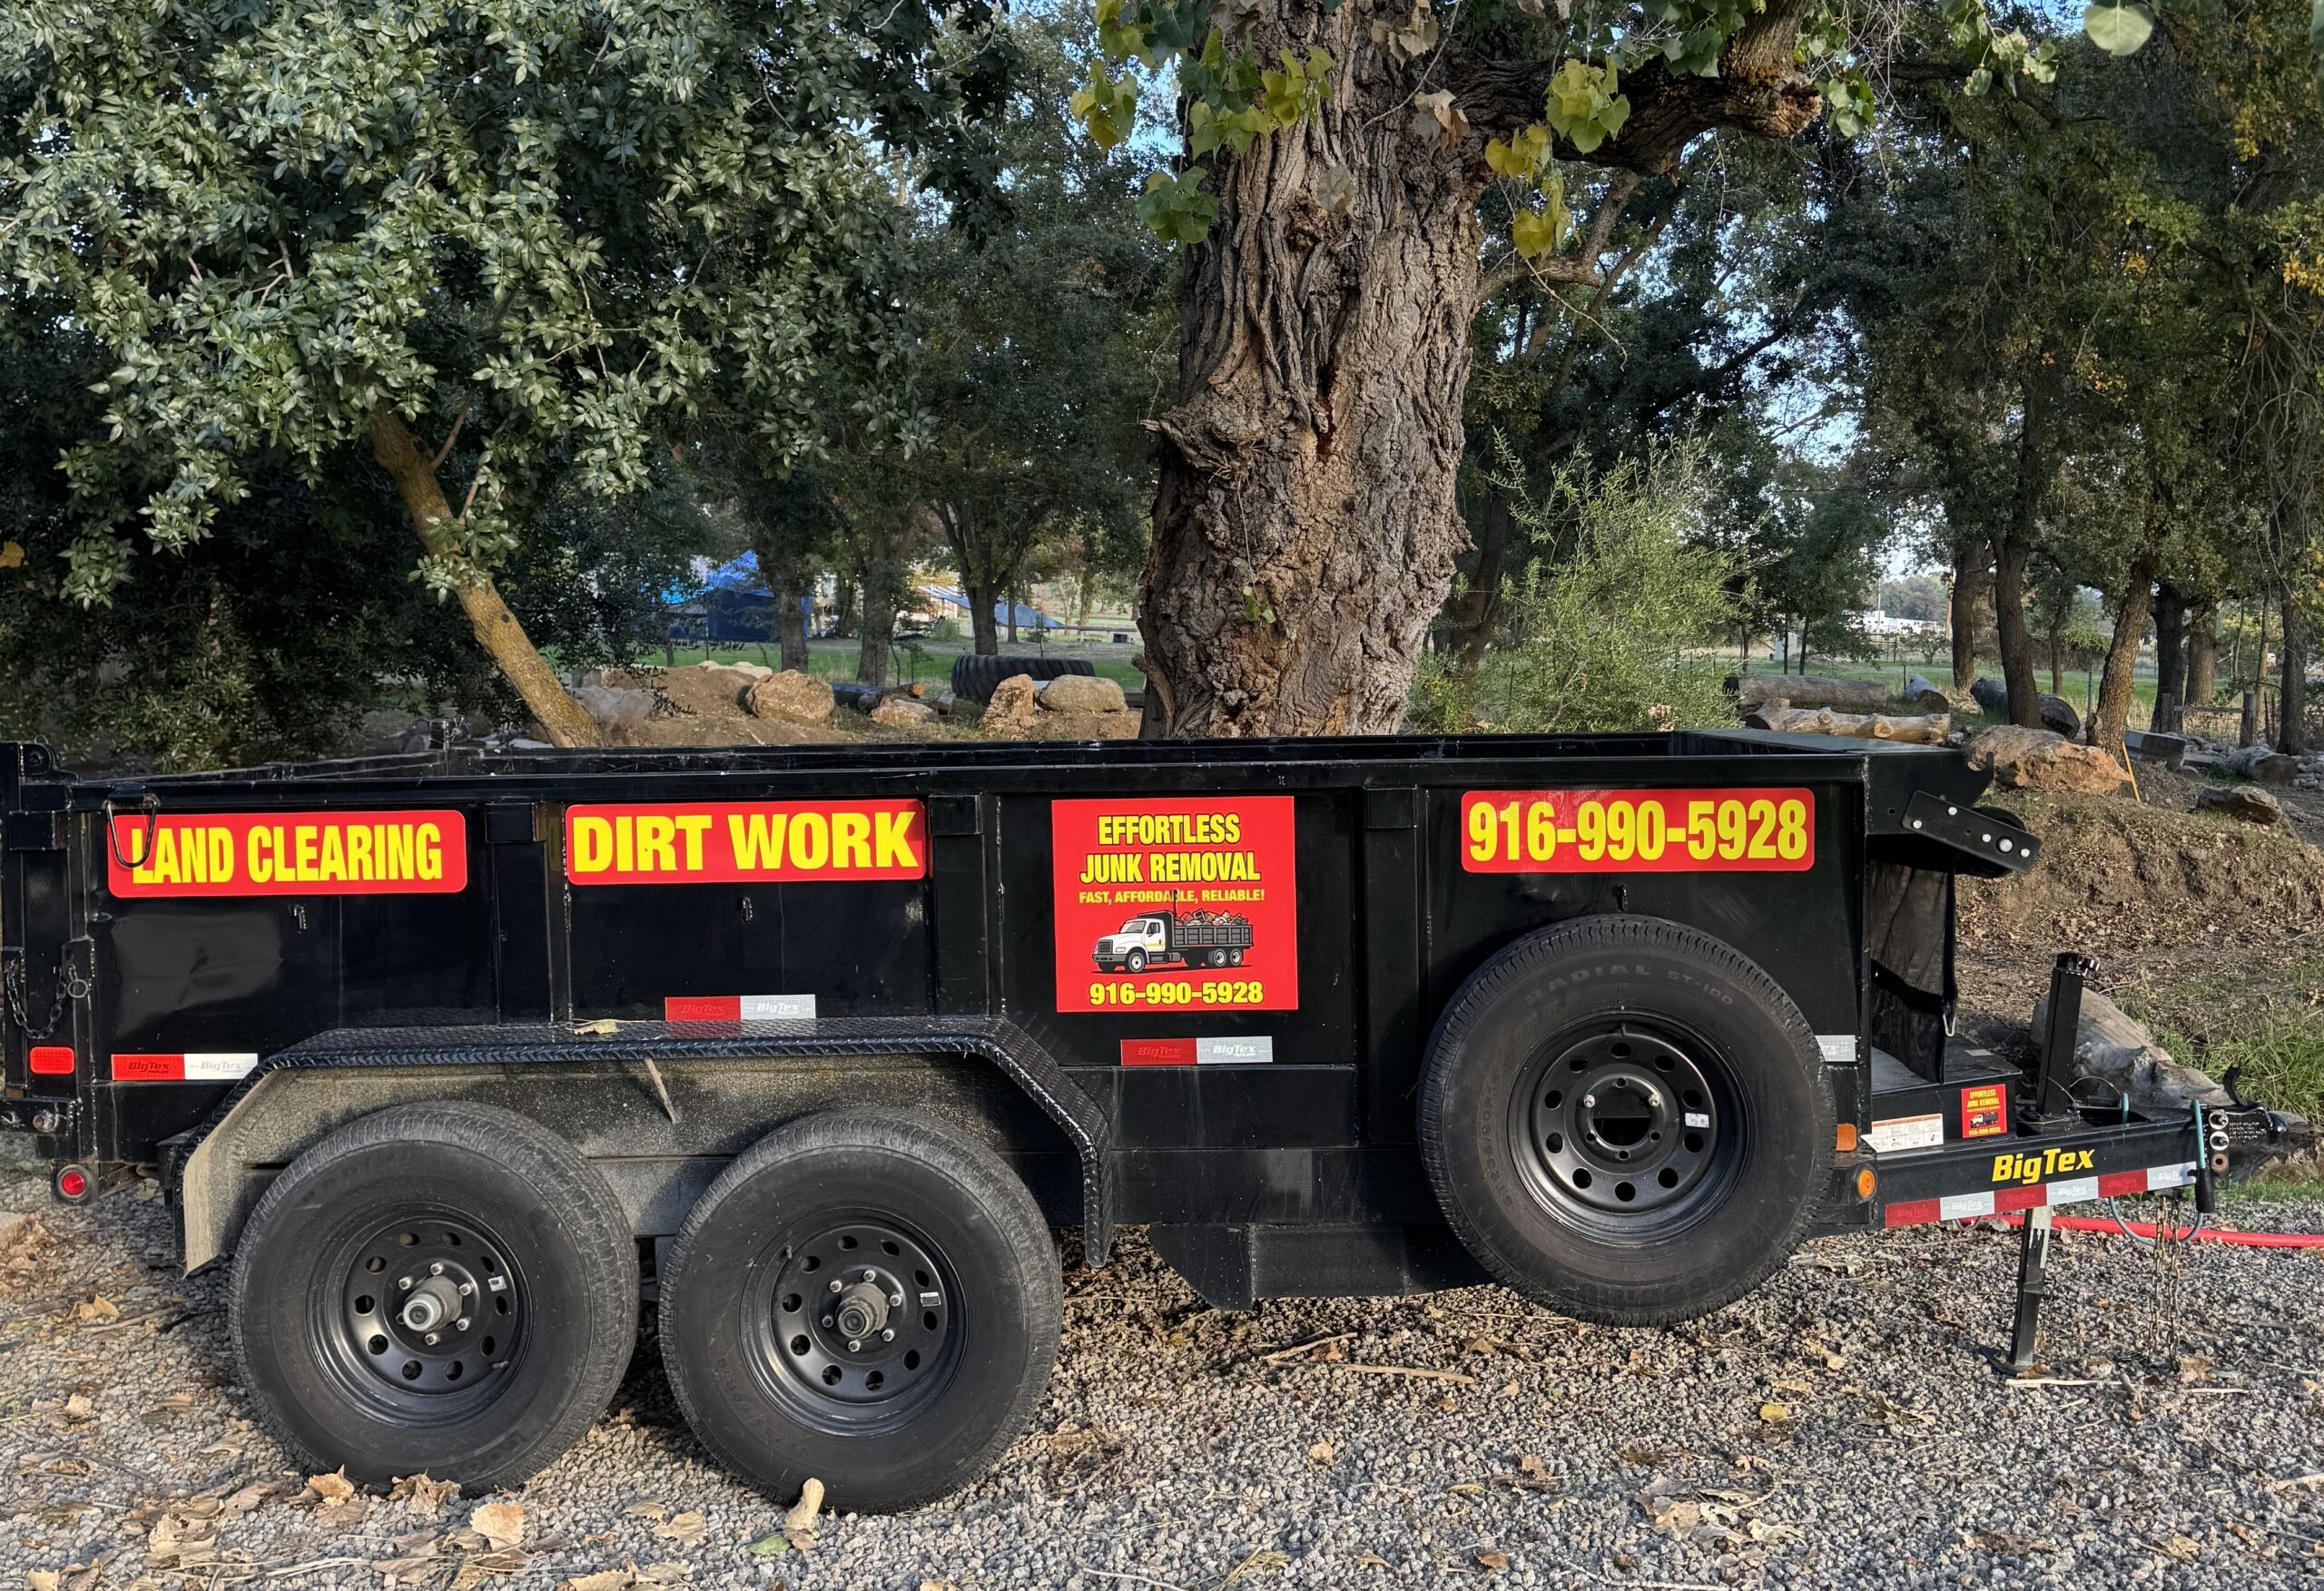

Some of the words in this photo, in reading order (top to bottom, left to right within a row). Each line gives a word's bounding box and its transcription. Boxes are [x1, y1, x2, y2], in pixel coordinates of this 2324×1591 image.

[573, 815, 712, 873] DIRT
[727, 811, 919, 870] WORK
[1098, 813, 1241, 845] EFFORTLESS
[1468, 799, 1807, 862] 916-990-5928
[131, 827, 234, 885] LAND
[247, 822, 443, 884] CLEARING
[1079, 853, 1144, 884] JUNK
[1149, 851, 1261, 882] REMOVAL
[1078, 890, 1112, 906] FAST,
[1201, 889, 1265, 902] RELIABLE!
[1089, 980, 1264, 1006] 916-990-5928
[756, 1002, 800, 1015] BigTex
[1137, 1046, 1181, 1058] BigTex
[1212, 1045, 1256, 1056] BigTex
[128, 1061, 170, 1072] BigTex
[201, 1061, 241, 1072] BigTex
[1992, 1148, 2095, 1184] BigTex
